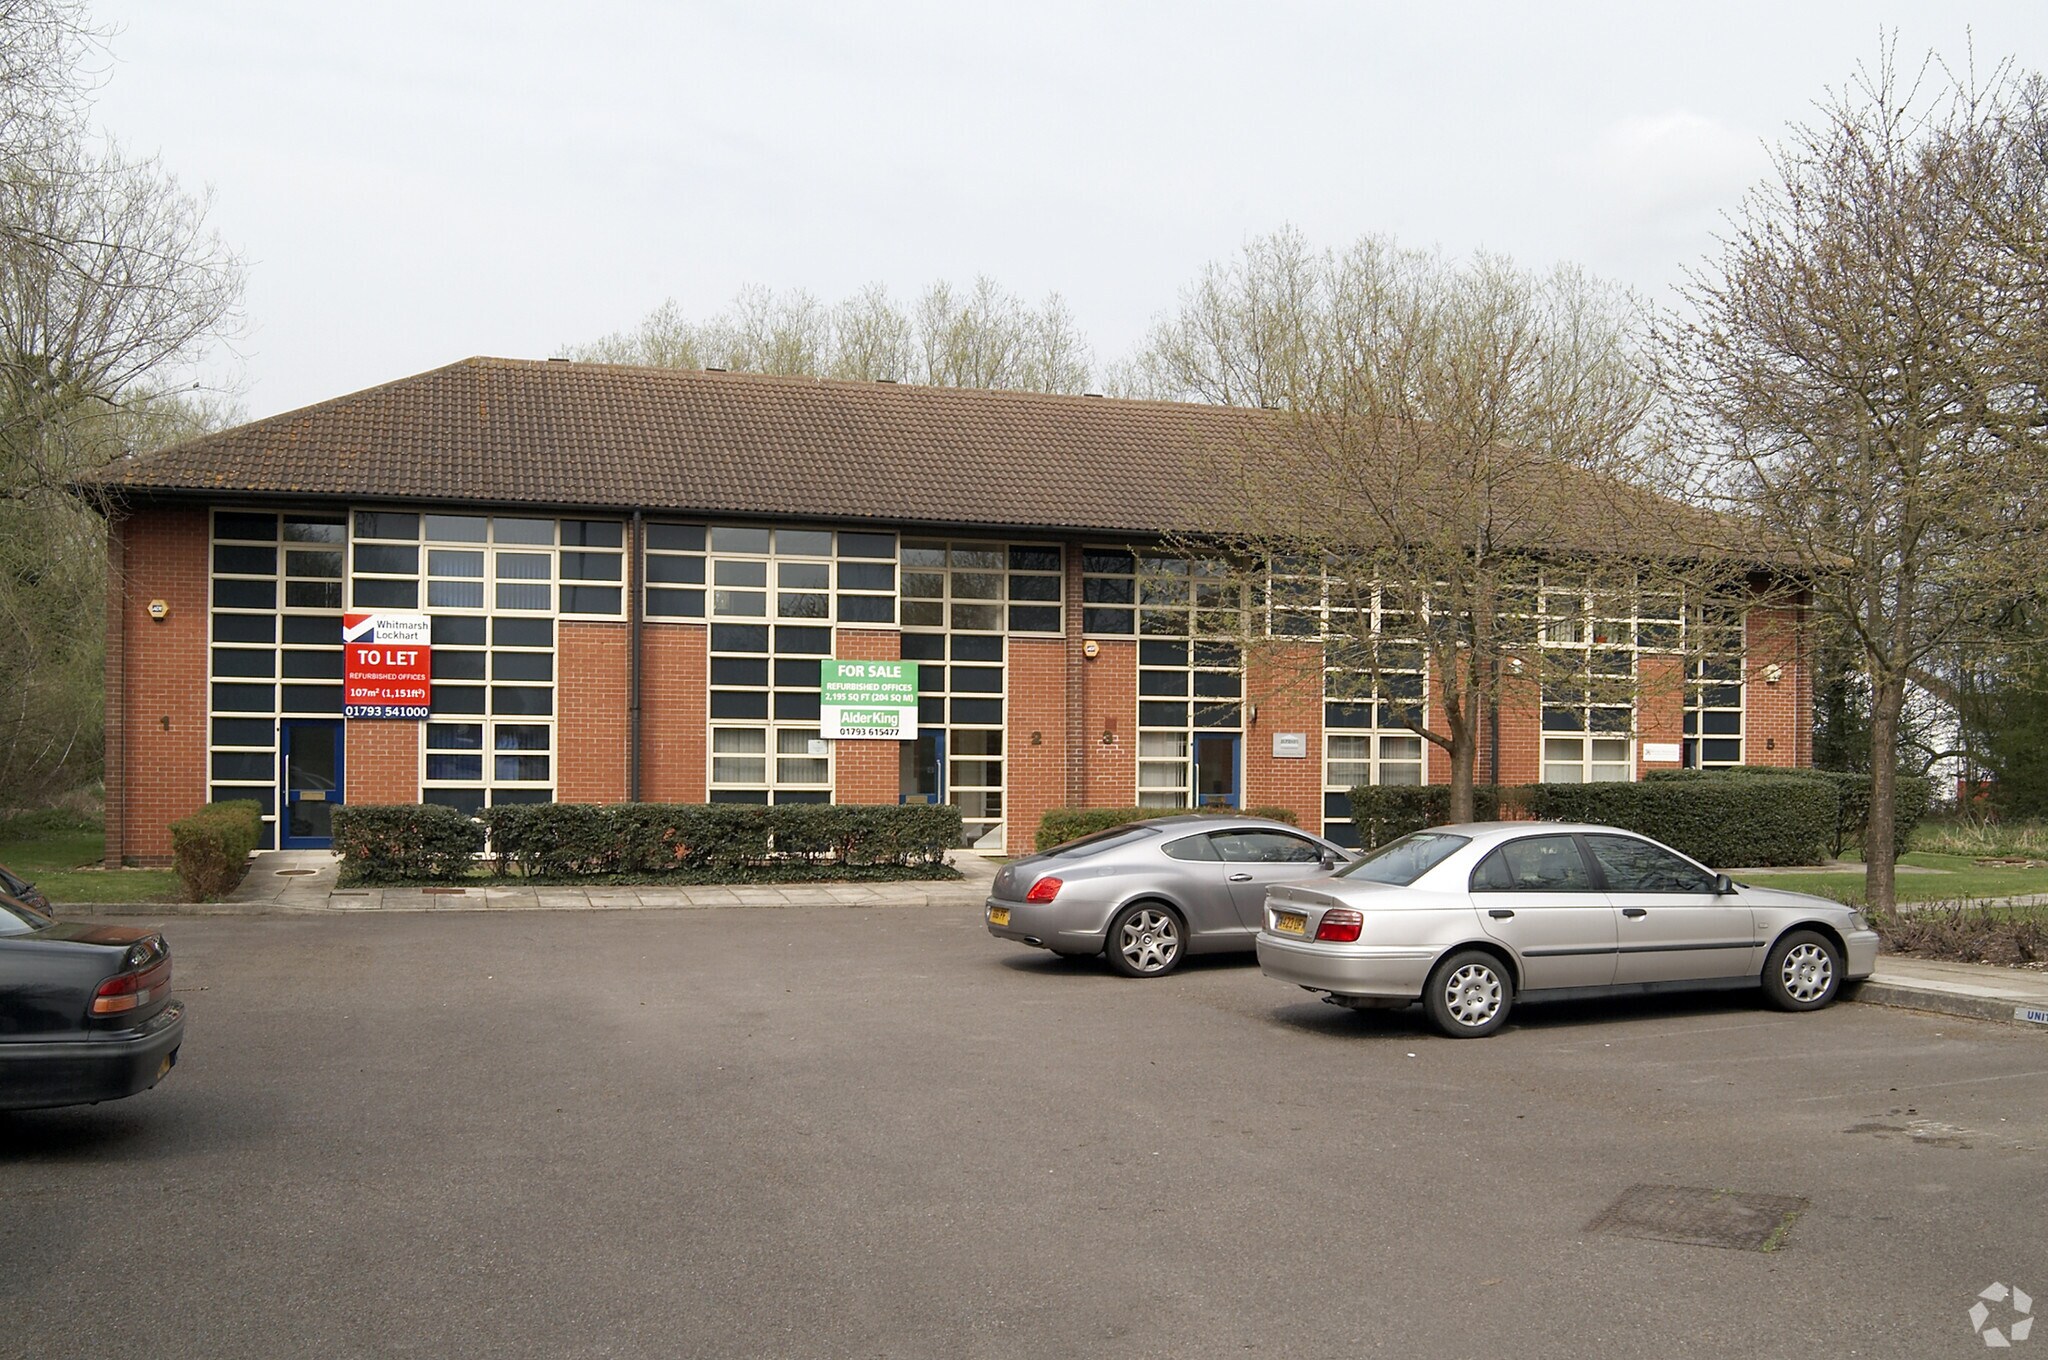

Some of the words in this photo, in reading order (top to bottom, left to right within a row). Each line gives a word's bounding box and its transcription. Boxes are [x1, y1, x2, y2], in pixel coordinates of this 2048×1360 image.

[377, 620, 428, 630] Whitmarsh
[376, 631, 418, 640] Lockhart
[357, 649, 381, 665] TO
[386, 650, 418, 666] LET
[838, 664, 865, 677] FOR
[868, 665, 902, 678] SALE
[349, 672, 397, 680] REFURBISHED
[398, 673, 426, 681] OFFICES
[350, 687, 380, 697] 107m²
[826, 682, 880, 691] REFURBISHED
[881, 683, 912, 692] OFFICES
[825, 692, 846, 702] 2,195
[848, 693, 859, 702] SQ
[861, 693, 870, 701] FT
[871, 693, 889, 702] (204
[890, 694, 902, 702] SQ
[902, 694, 914, 703] M)
[345, 705, 382, 716] 01793
[385, 706, 428, 717] 541000
[839, 727, 866, 736] 01793
[868, 728, 900, 736] 615477
[1031, 731, 1042, 745] 2
[1102, 730, 1114, 745] 3
